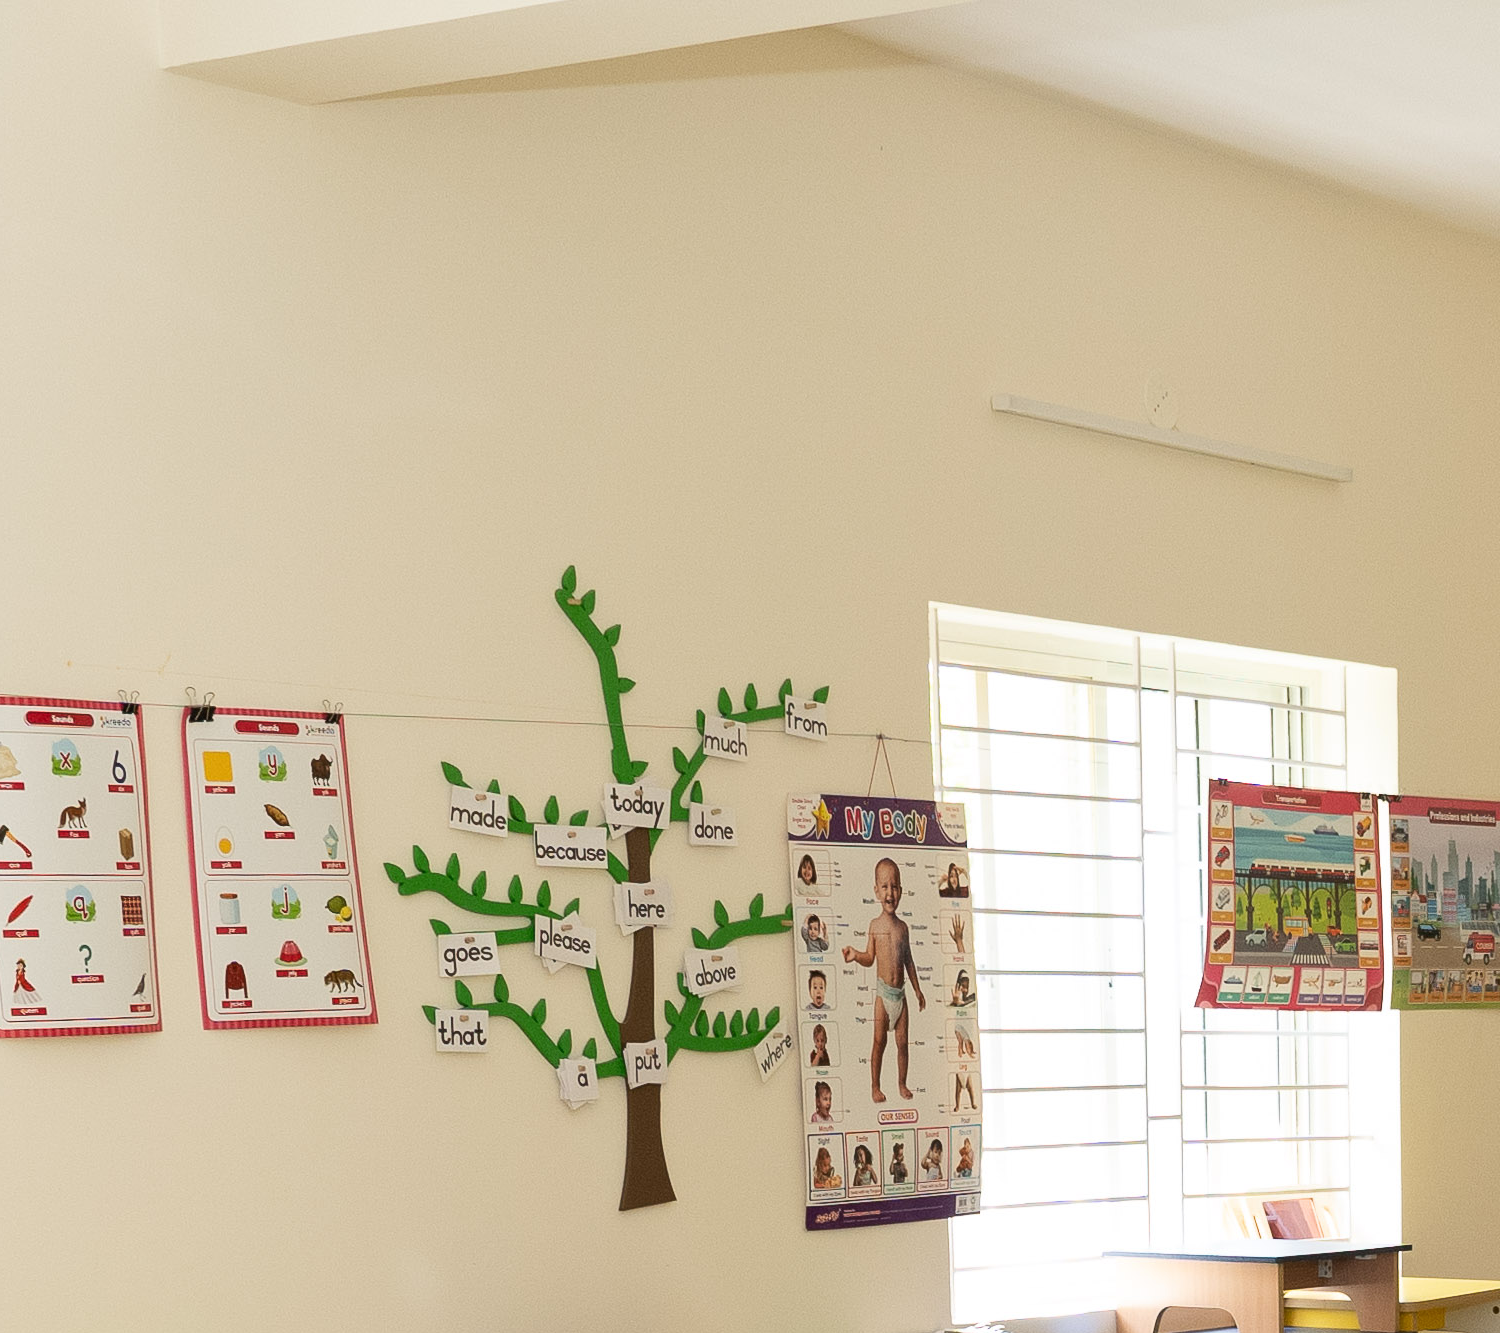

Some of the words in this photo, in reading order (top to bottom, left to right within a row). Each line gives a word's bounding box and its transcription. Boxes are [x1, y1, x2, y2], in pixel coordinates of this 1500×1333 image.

[786, 702, 828, 737] from
[704, 728, 748, 757] much
[60, 752, 72, 769] x
[112, 750, 127, 784] 6
[267, 754, 278, 776] y
[450, 800, 507, 830] made
[610, 787, 665, 830] today
[1429, 810, 1461, 823] Professions
[1471, 812, 1497, 826] Industries
[694, 813, 734, 841] done
[844, 805, 875, 840] My
[878, 807, 928, 844] Body
[535, 829, 606, 862] because
[73, 896, 88, 919] q
[280, 886, 289, 915] j
[628, 889, 666, 920] here
[539, 918, 592, 958] please
[443, 943, 494, 977] goes
[695, 960, 736, 986] above
[809, 1013, 828, 1021] Tongue
[438, 1020, 487, 1047] that
[635, 1050, 662, 1084] put
[760, 1031, 793, 1075] where
[577, 1070, 589, 1088] a
[880, 1112, 894, 1121] OUR
[895, 1111, 915, 1120] SENSES
[818, 1137, 830, 1146] Sight
